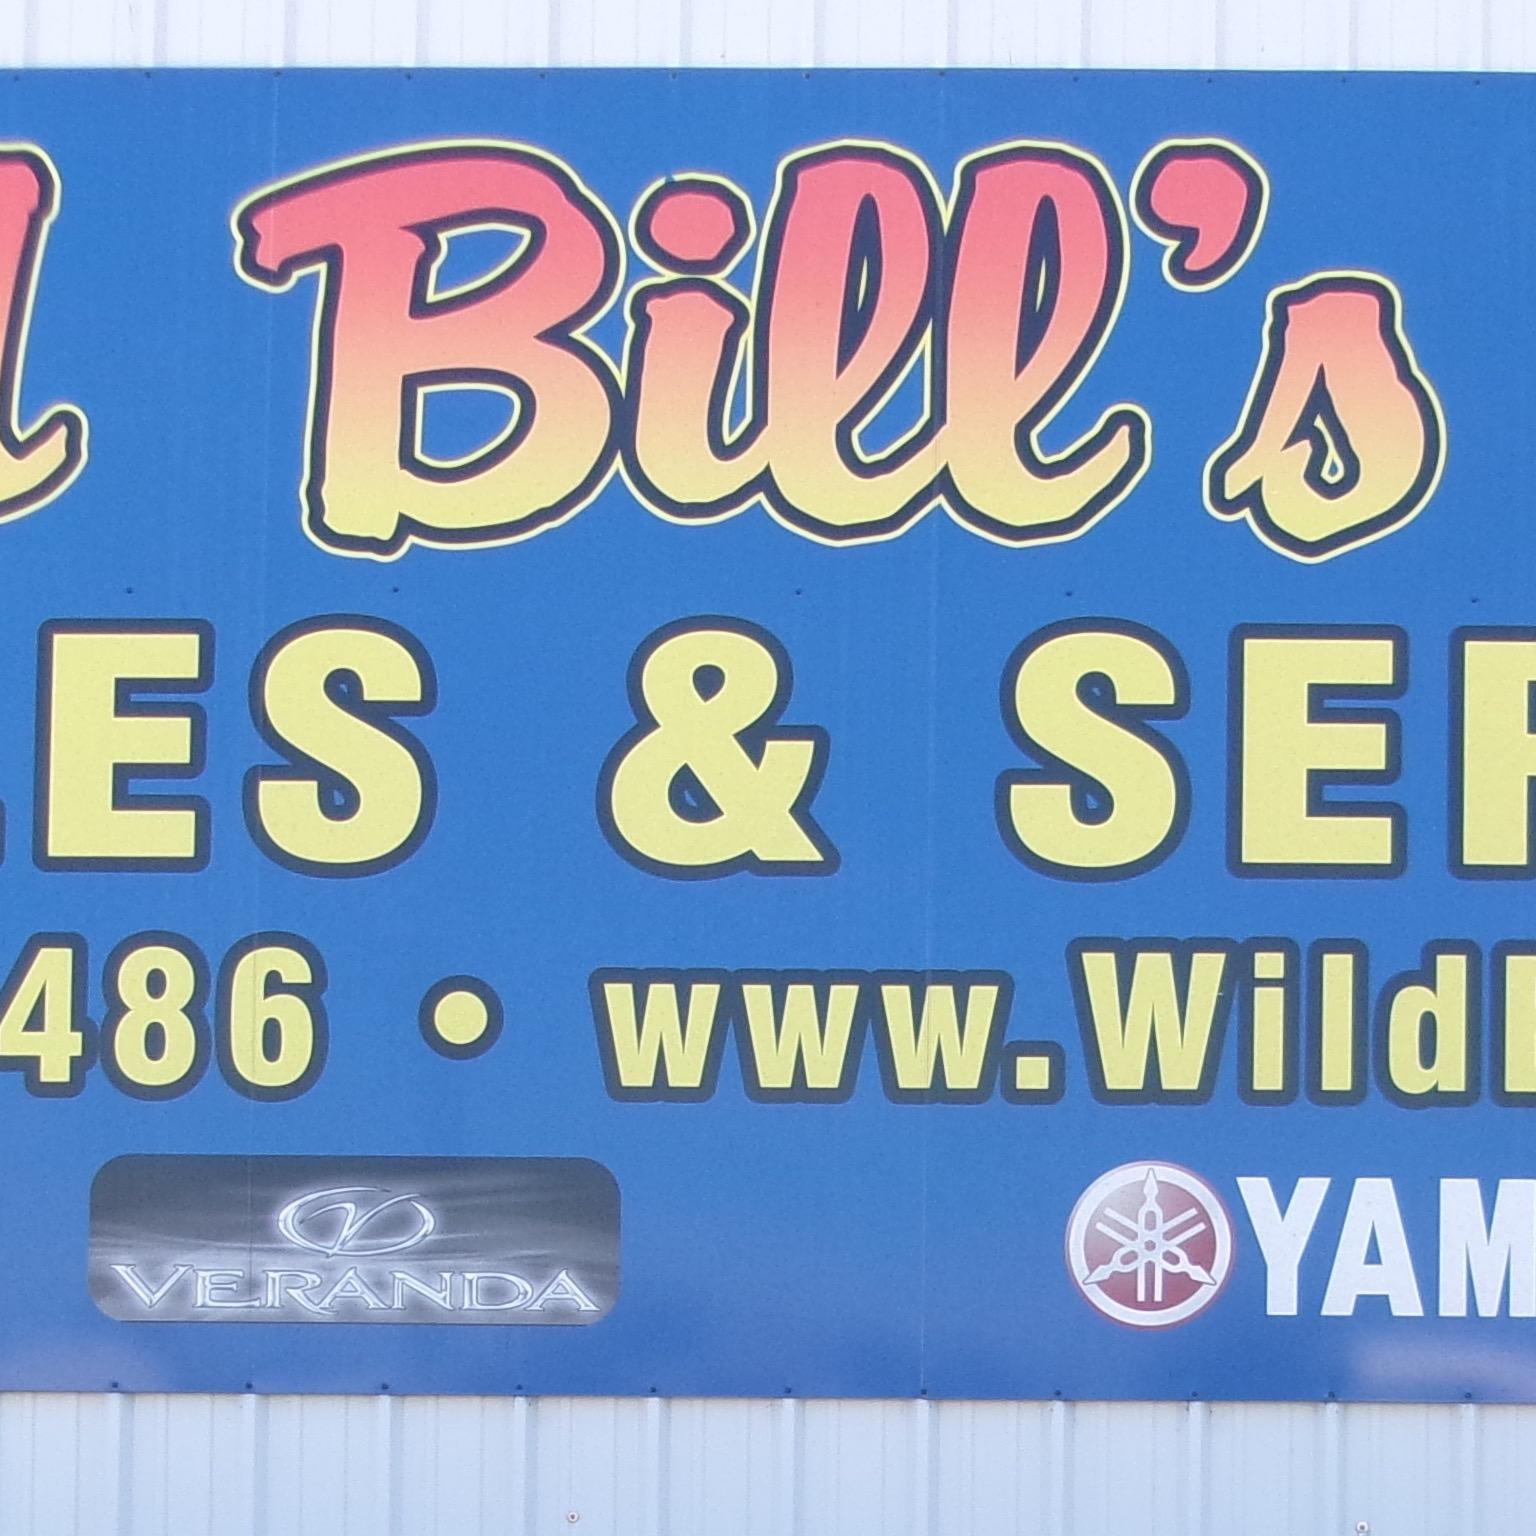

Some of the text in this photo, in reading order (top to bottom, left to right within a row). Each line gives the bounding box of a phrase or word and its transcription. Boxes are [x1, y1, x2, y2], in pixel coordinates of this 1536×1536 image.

[238, 143, 1438, 555] Bill's
[607, 624, 826, 870] &
[110, 1264, 600, 1315] VERANDA
